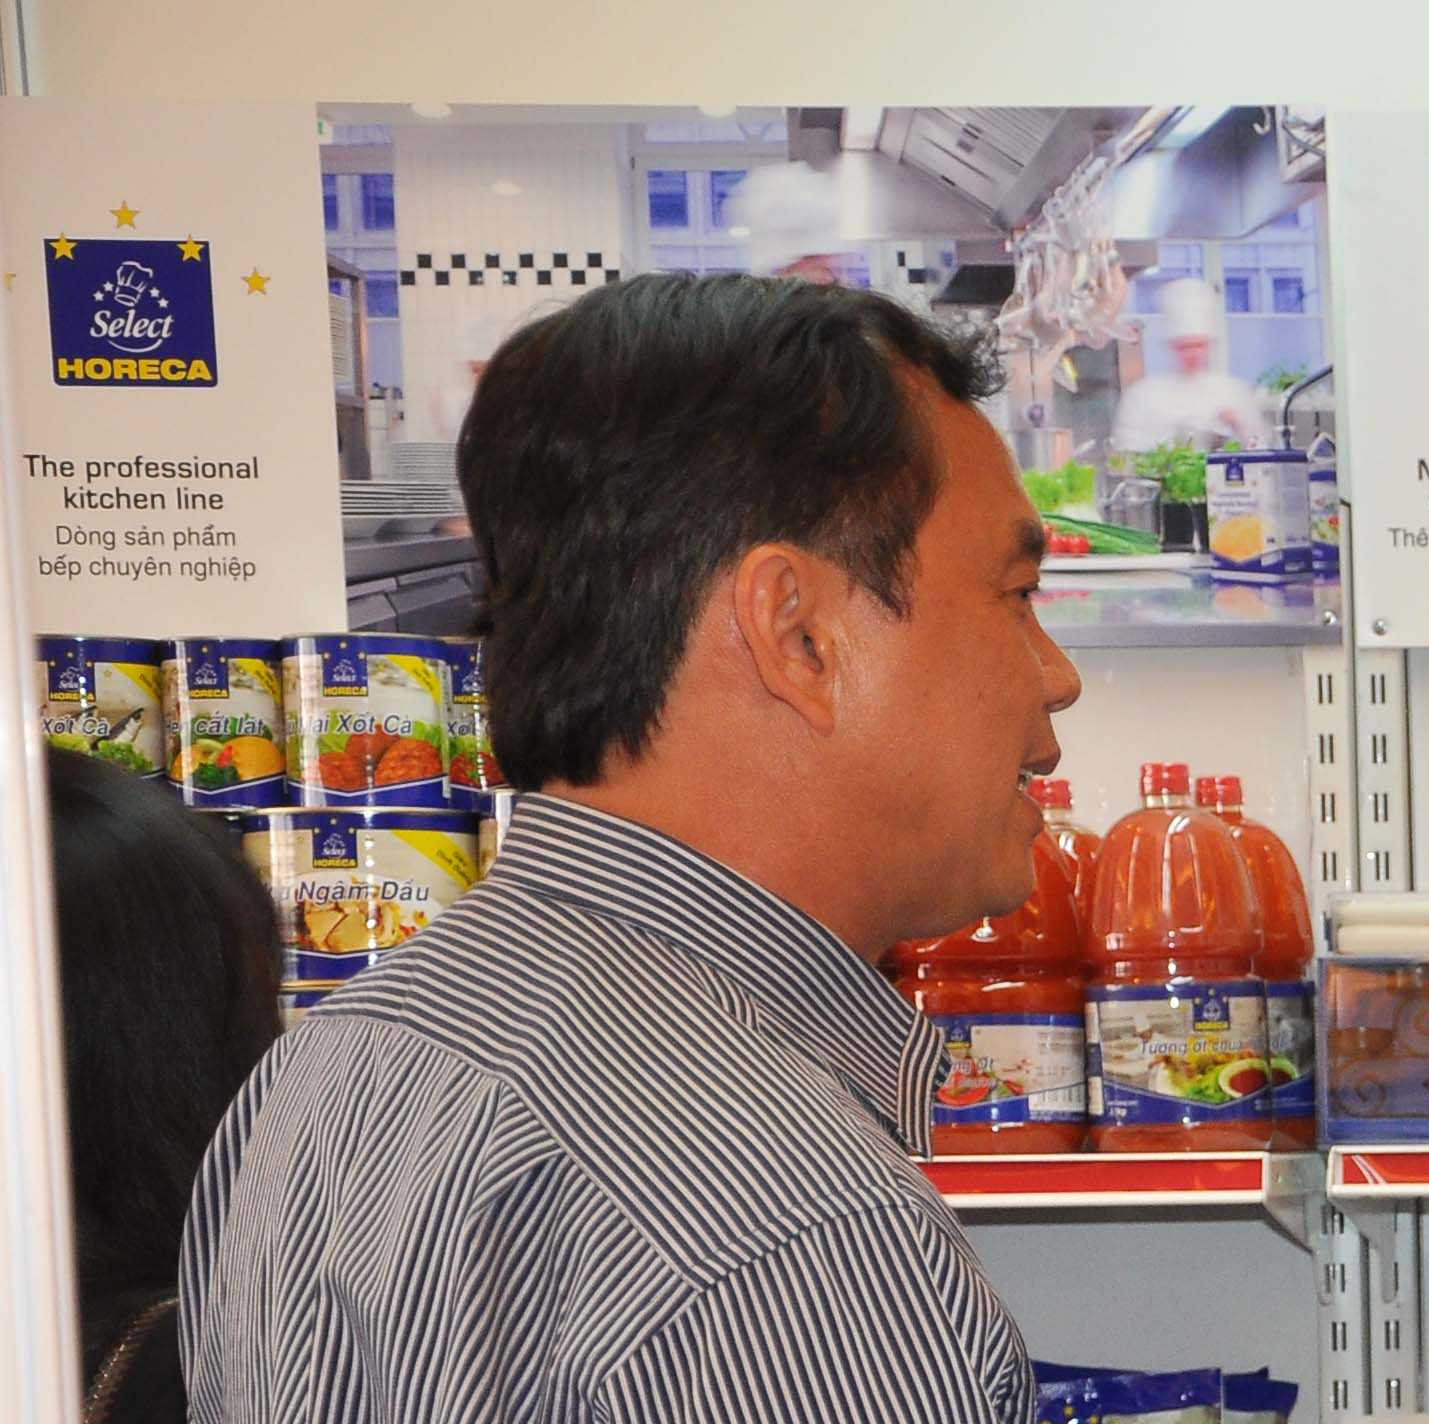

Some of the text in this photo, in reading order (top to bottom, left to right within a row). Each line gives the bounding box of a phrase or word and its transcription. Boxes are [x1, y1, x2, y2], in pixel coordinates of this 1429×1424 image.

[90, 309, 174, 338] Select
[57, 357, 213, 381] HORECA
[23, 454, 259, 484] The professional
[63, 486, 224, 510] kitchen line
[55, 523, 237, 551] Dòng sản phẩm
[38, 553, 257, 582] bếp chuyên nghiệp
